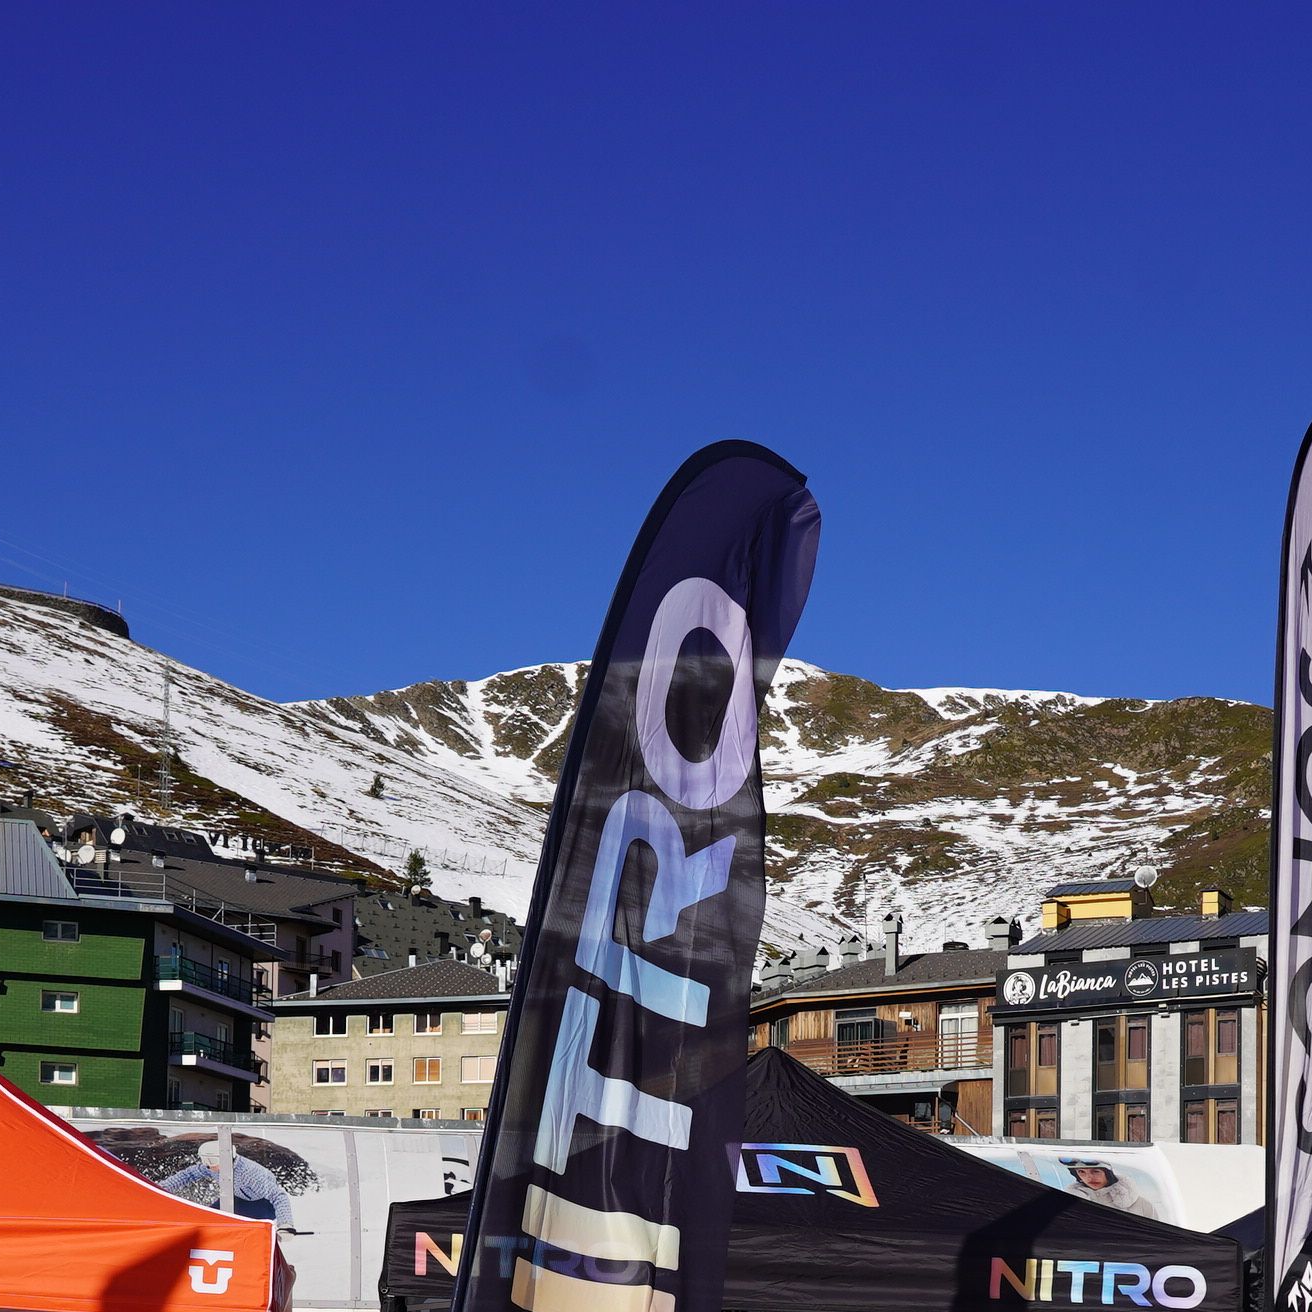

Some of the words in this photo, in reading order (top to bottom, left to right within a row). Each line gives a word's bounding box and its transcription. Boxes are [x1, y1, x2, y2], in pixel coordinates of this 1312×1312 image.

[1163, 958, 1220, 975] HOTEL
[1163, 976, 1188, 989] LES
[1195, 971, 1249, 987] PISTES
[990, 1257, 1207, 1309] NITRO
